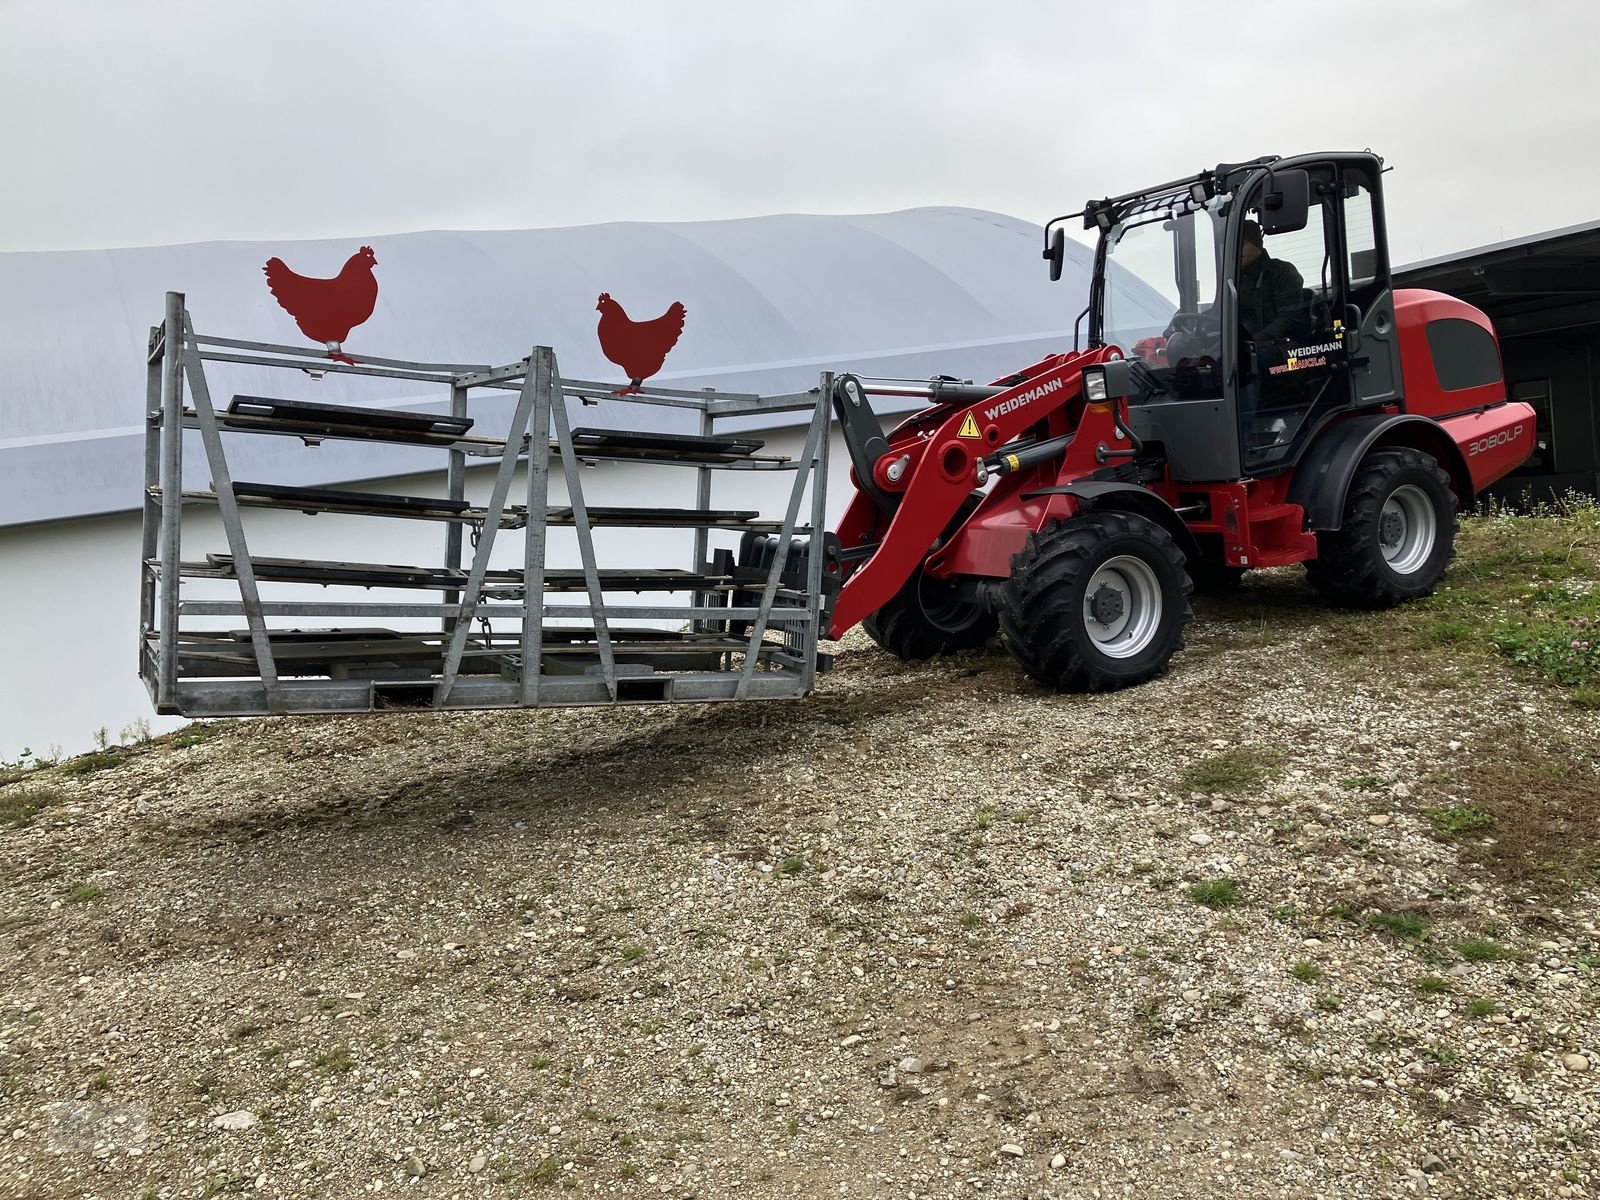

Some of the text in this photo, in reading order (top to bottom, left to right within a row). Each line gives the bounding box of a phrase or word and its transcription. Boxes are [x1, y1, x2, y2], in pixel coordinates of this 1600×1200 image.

[1288, 341, 1342, 357] WEIDEMANN
[984, 378, 1063, 420] WEIDEMANN
[1469, 425, 1523, 456] 3080LP
